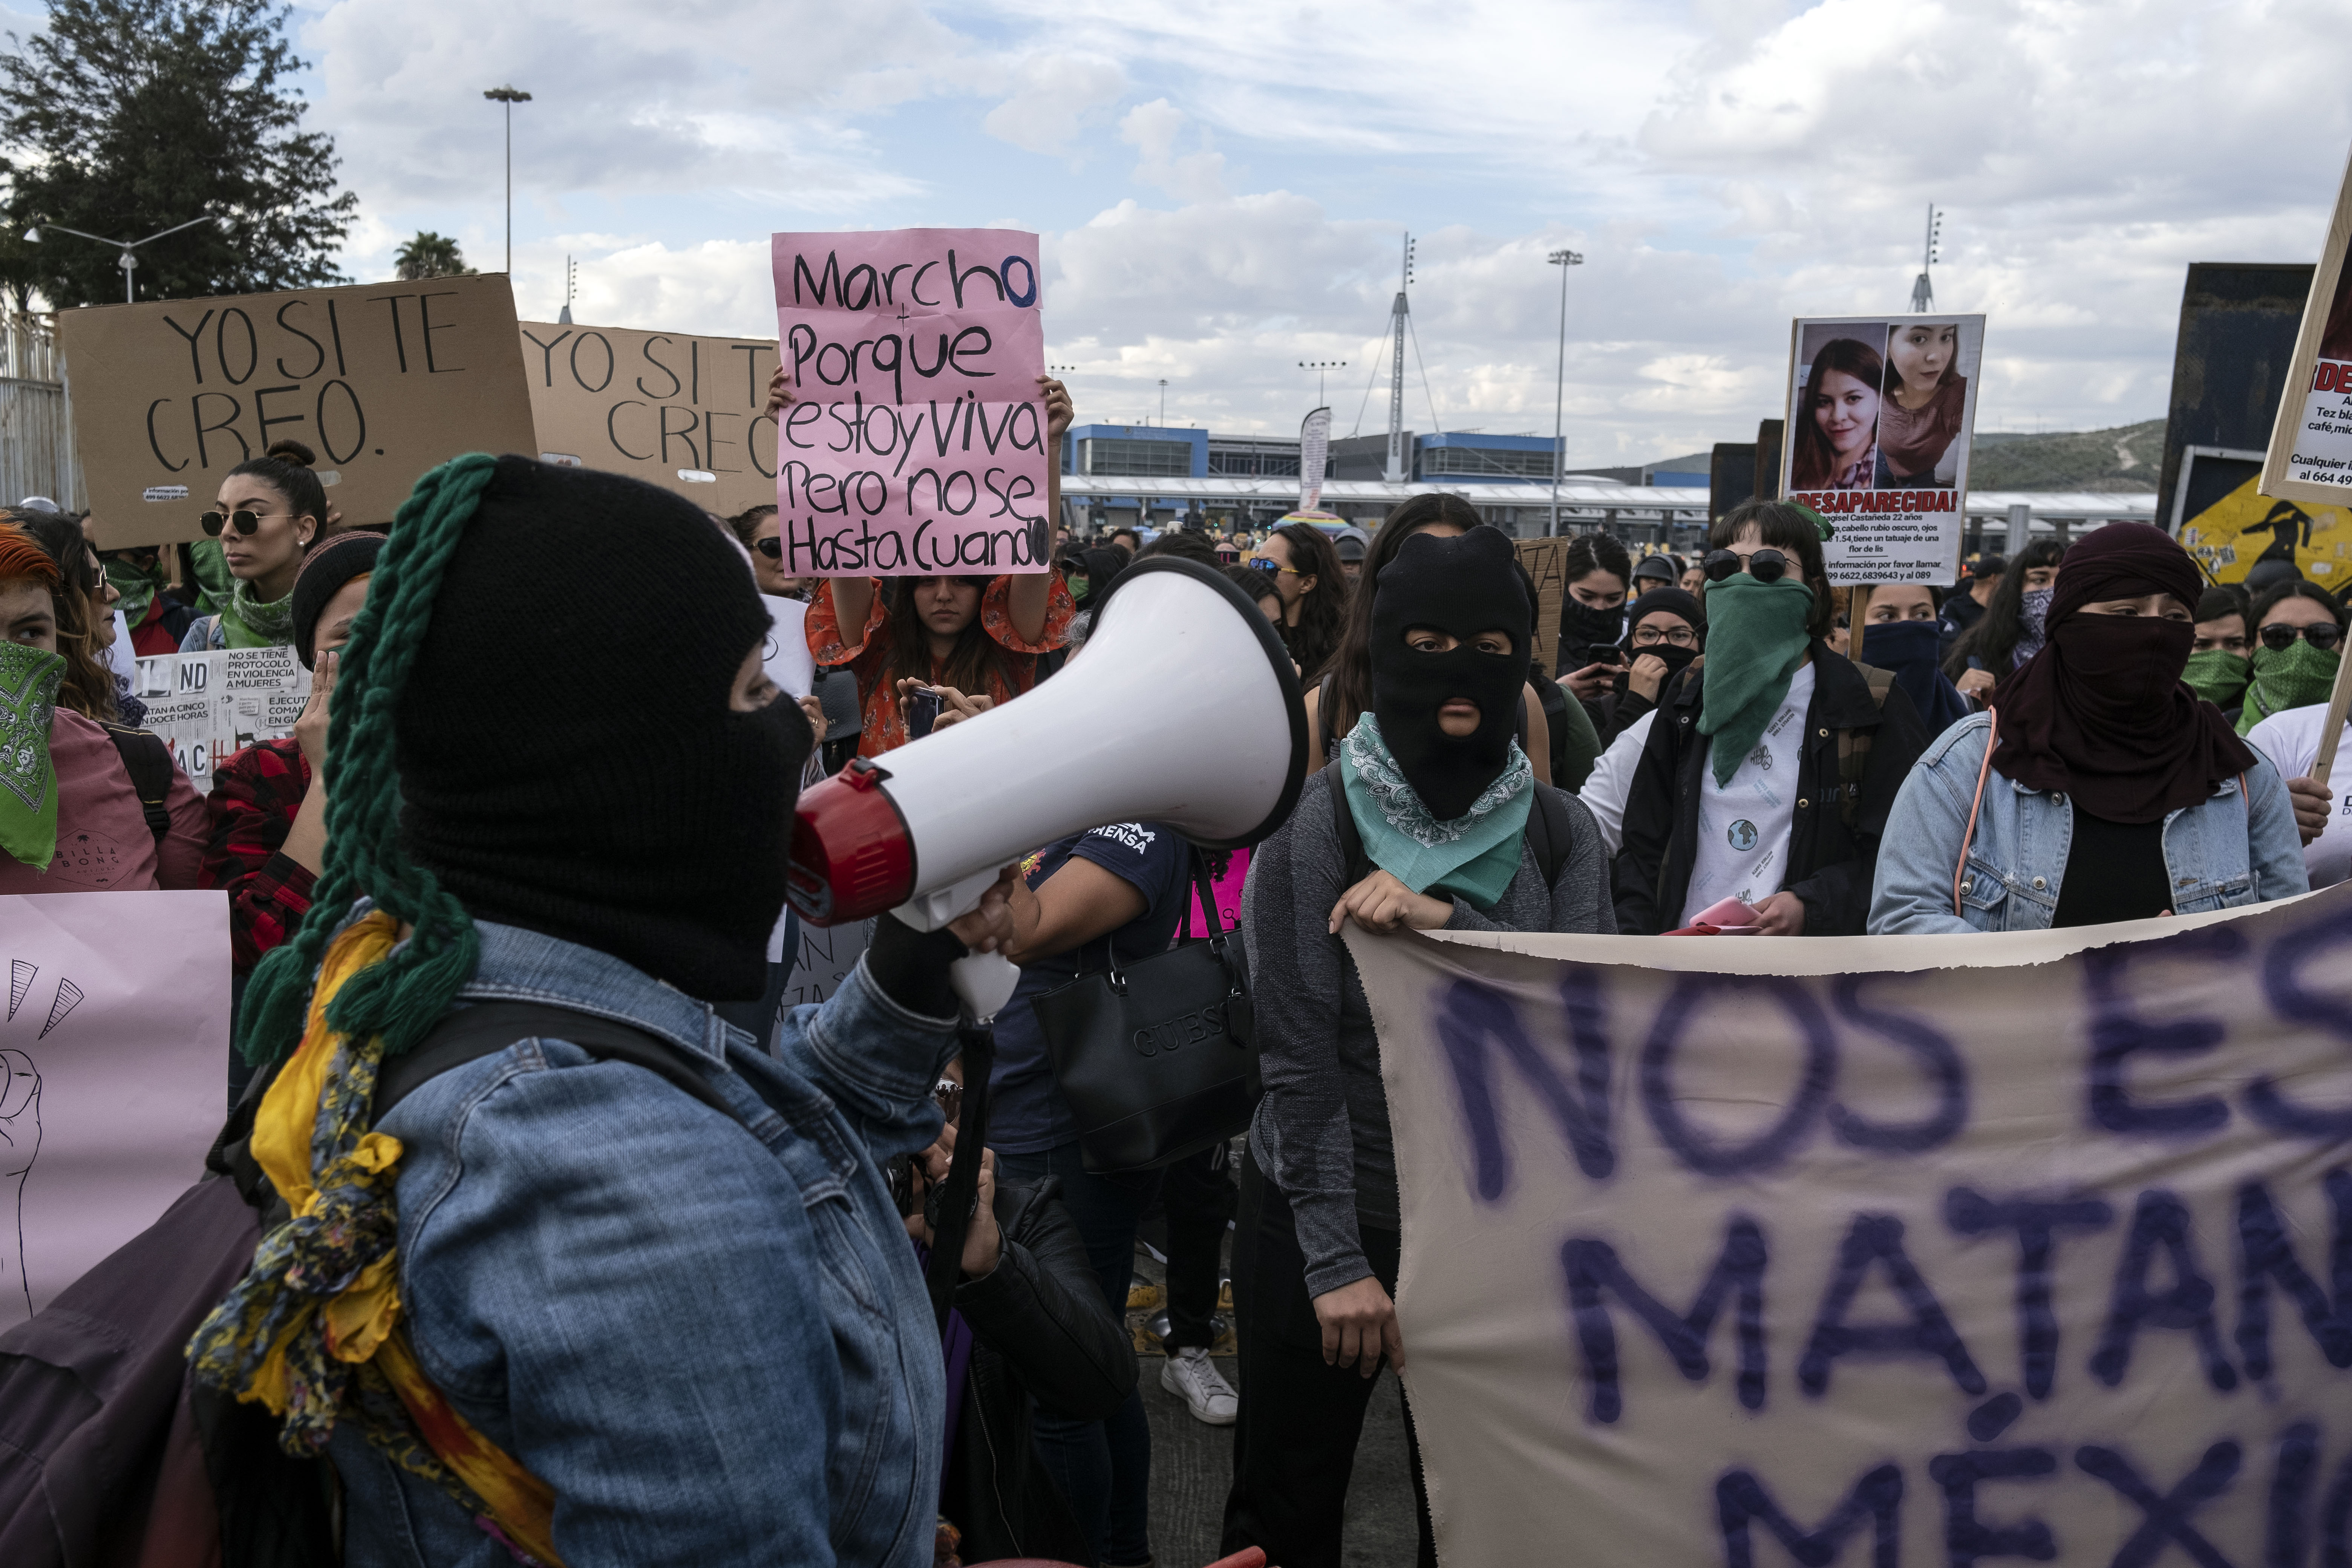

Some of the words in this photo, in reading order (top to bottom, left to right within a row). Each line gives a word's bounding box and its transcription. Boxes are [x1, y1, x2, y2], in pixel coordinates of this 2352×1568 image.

[793, 249, 1037, 311] Marcho
[163, 307, 258, 385] YO
[277, 299, 346, 379] SI
[366, 292, 466, 374] TE
[522, 329, 614, 392] YO
[637, 336, 699, 405] SI
[731, 345, 774, 408] T
[789, 323, 996, 407] Porque
[2317, 407, 2336, 418] Tez
[786, 390, 925, 478] estoy
[2291, 453, 2346, 471] Cualquier
[2299, 470, 2311, 480] al
[2312, 472, 2334, 483] 664
[782, 460, 888, 516] Pero
[908, 468, 977, 516] no
[1789, 491, 1958, 513] DESAPARECIDA!
[1922, 524, 1937, 533] ojos
[788, 514, 908, 573] Hasta
[1885, 534, 1912, 543] tatuaje
[1828, 560, 1877, 568] información
[1916, 559, 1942, 568] llamar
[228, 660, 291, 669] PROTOCOLO
[243, 669, 295, 678] VIOLENCIA
[227, 680, 234, 688] A
[235, 678, 282, 688] MUJERES
[146, 705, 168, 715] TAN
[177, 702, 205, 712] CINCO
[150, 714, 176, 724] DOCE
[177, 710, 208, 721] HORAS
[1088, 825, 1146, 855] RENSA
[56, 847, 116, 858] BILLA
[1435, 966, 1971, 1202] NOS
[1715, 1391, 2352, 1568] MÉXI
